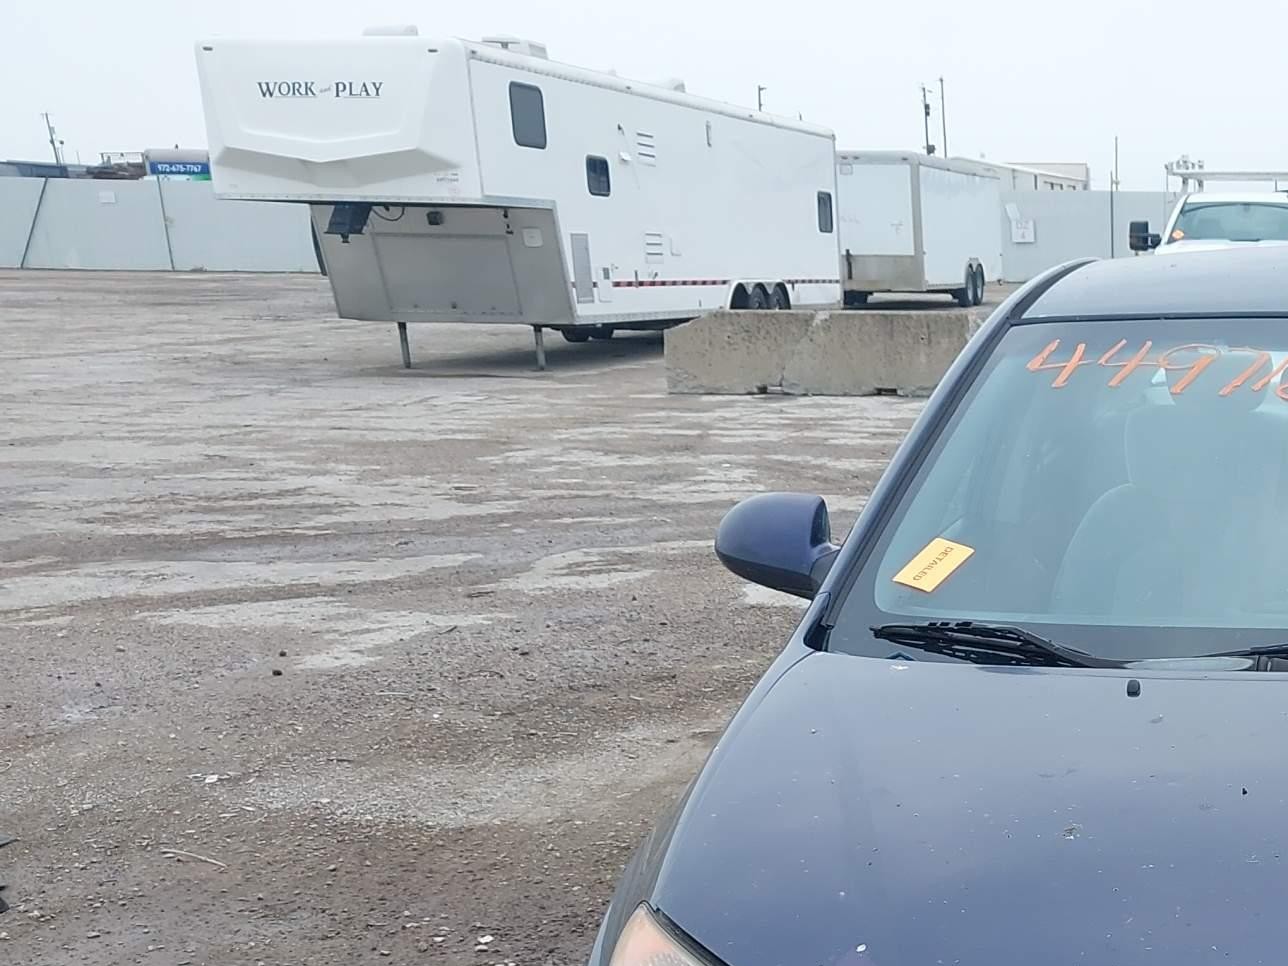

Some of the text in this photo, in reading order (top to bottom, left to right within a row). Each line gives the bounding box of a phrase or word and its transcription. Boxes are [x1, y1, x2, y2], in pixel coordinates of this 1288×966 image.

[257, 81, 316, 98] WORK
[334, 81, 383, 98] PLAY
[912, 546, 955, 582] DETAILED
